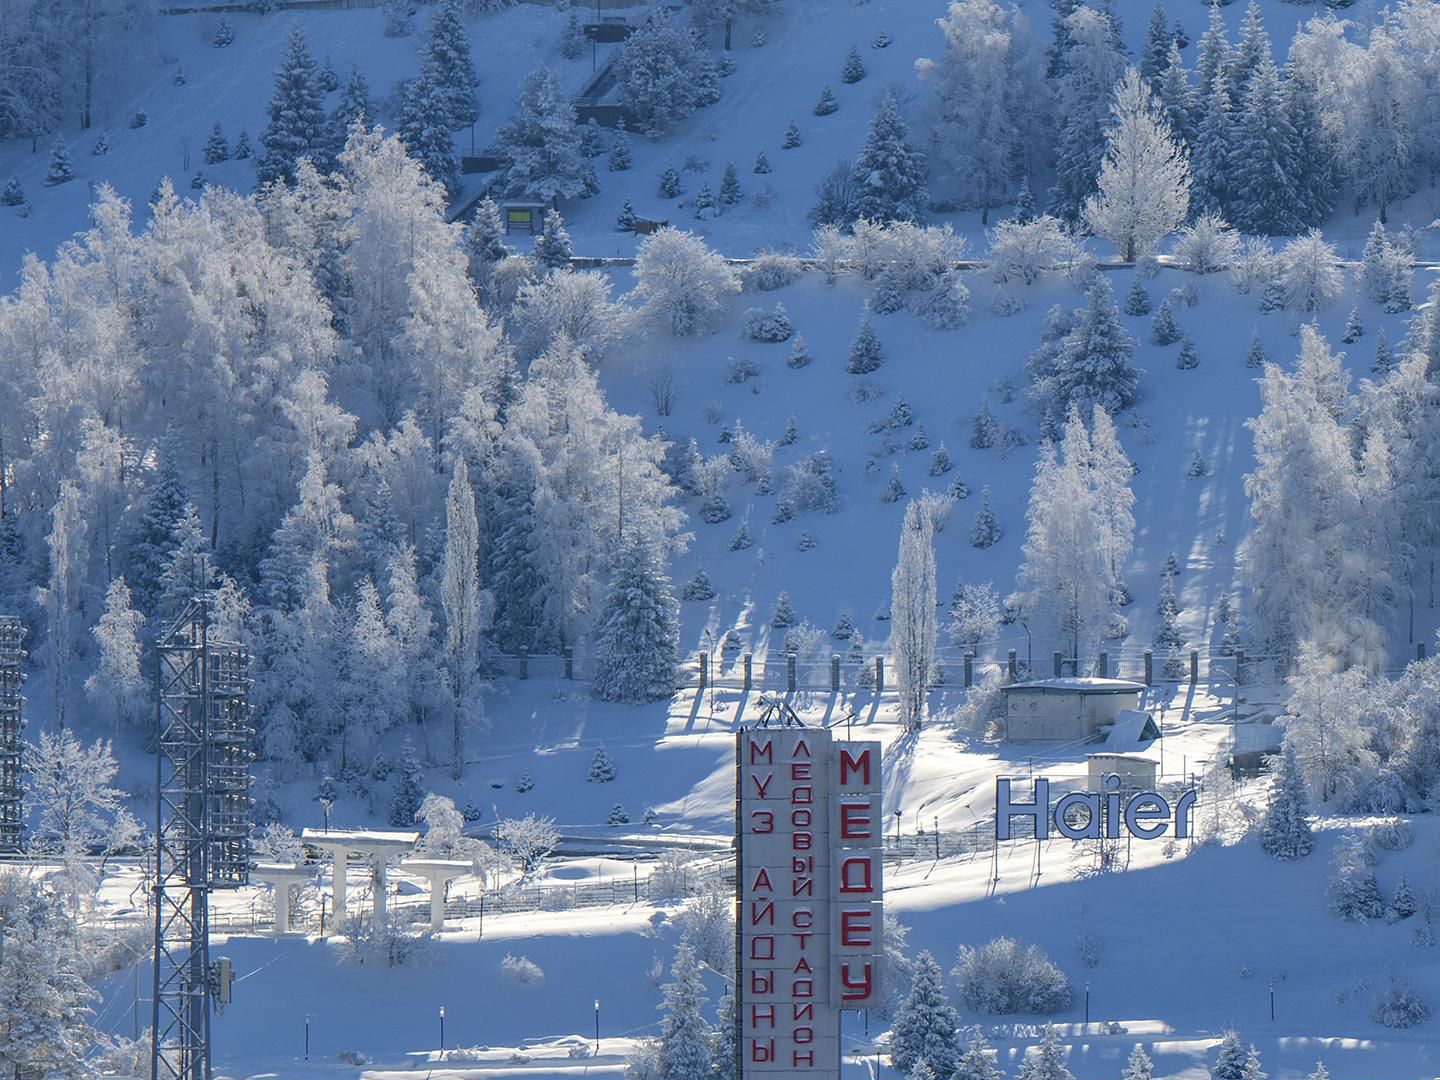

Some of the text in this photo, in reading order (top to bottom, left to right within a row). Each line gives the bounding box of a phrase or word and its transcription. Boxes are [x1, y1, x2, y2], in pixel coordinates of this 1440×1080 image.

[791, 740, 813, 1067] ЛЕДОВЫЙ СТАДИОН
[840, 748, 872, 1000] МЕДЕУ
[996, 773, 1197, 840] Haier
[751, 867, 774, 1062] АЙДЫНЫ
